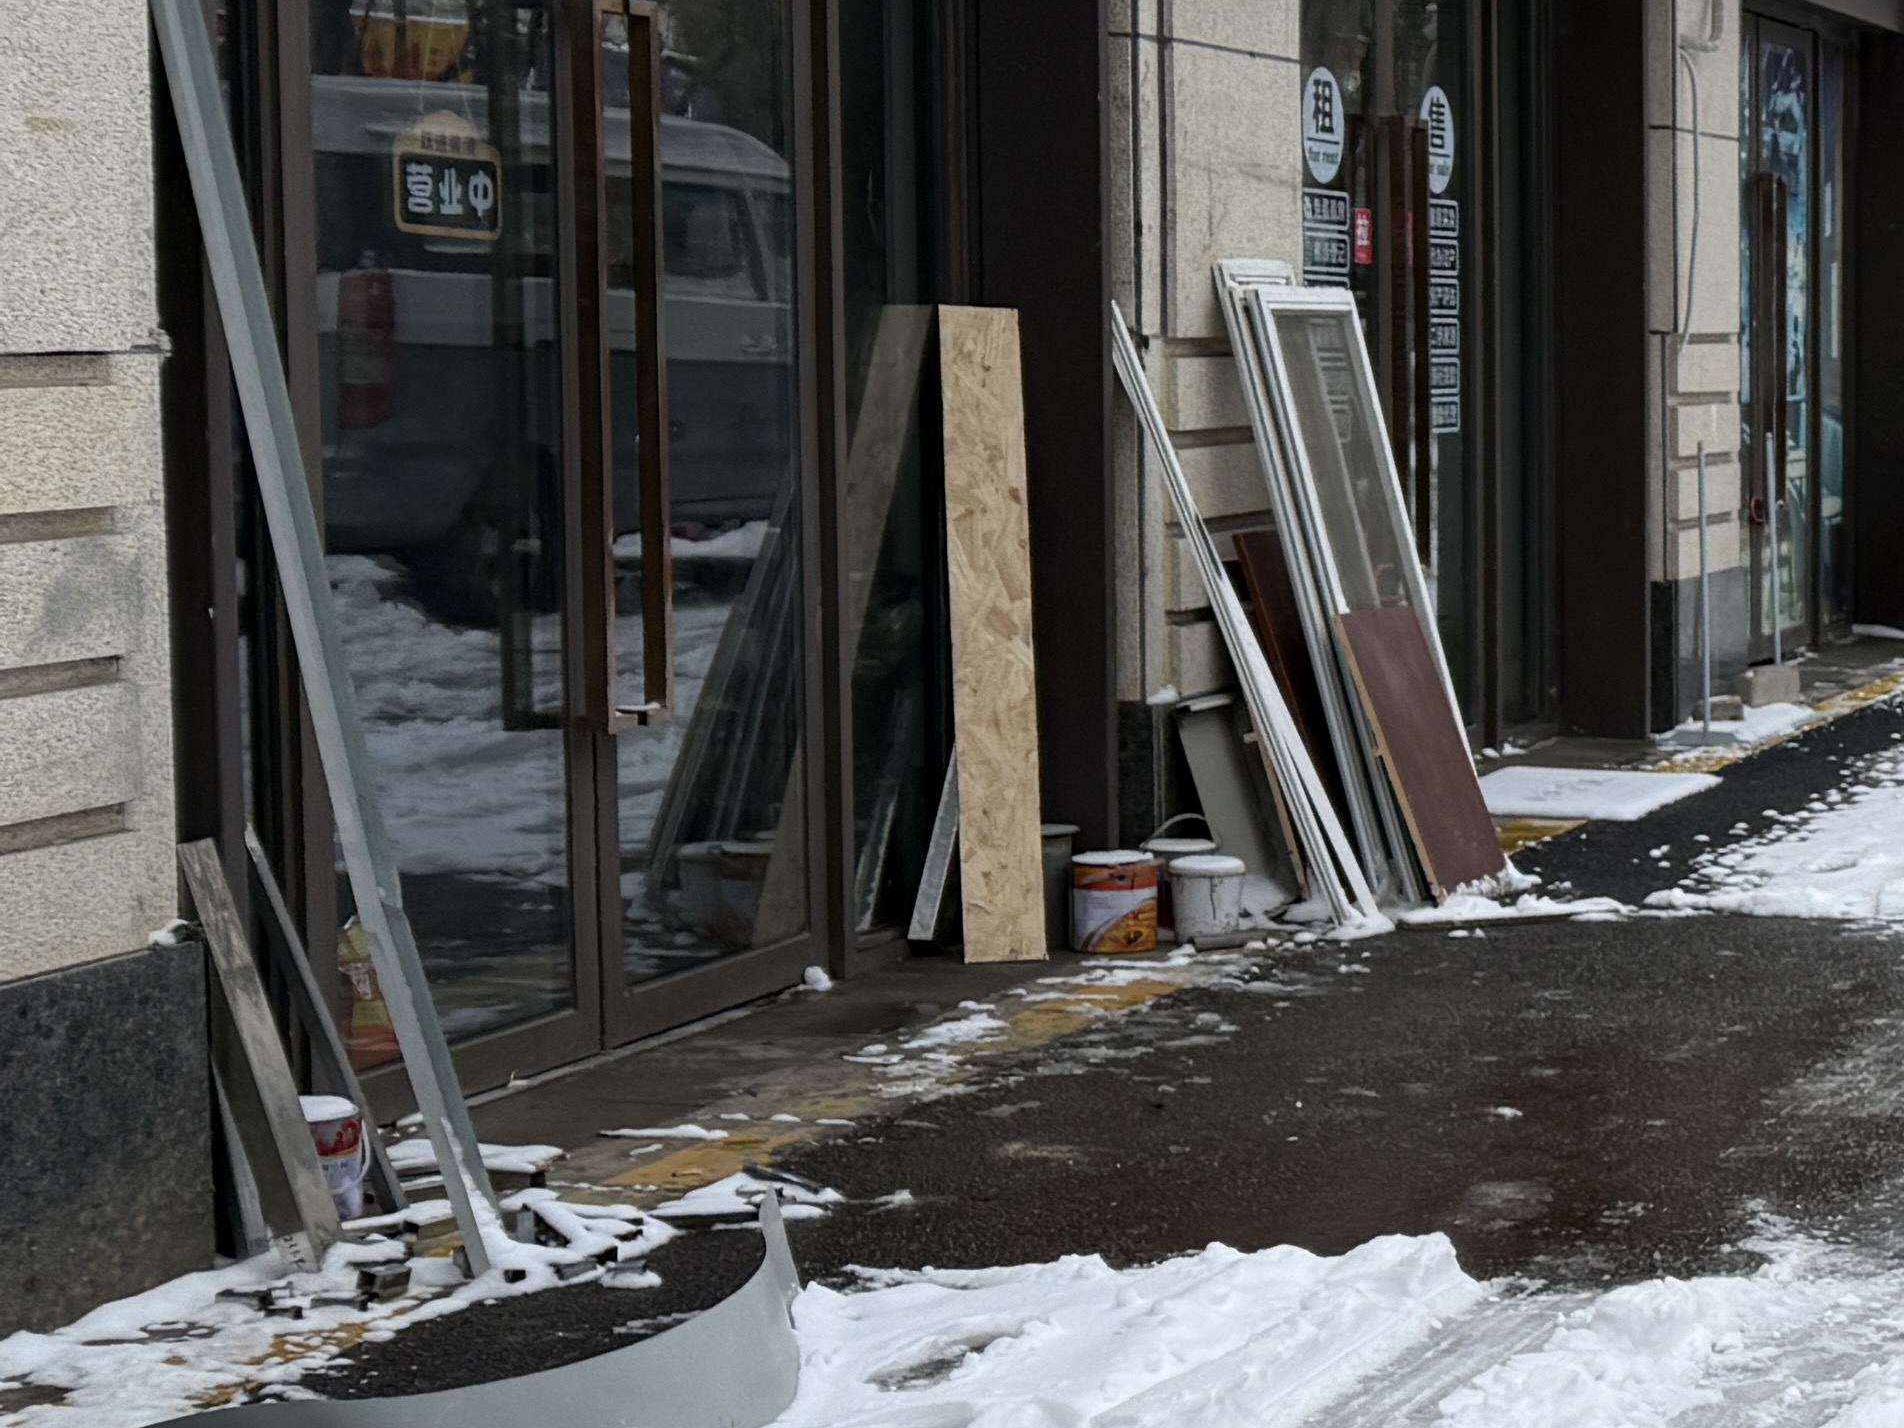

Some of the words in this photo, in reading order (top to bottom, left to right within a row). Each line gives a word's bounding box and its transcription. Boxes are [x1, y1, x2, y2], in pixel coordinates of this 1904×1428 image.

[1312, 78, 1335, 134] 租
[406, 162, 495, 218] 营业中
